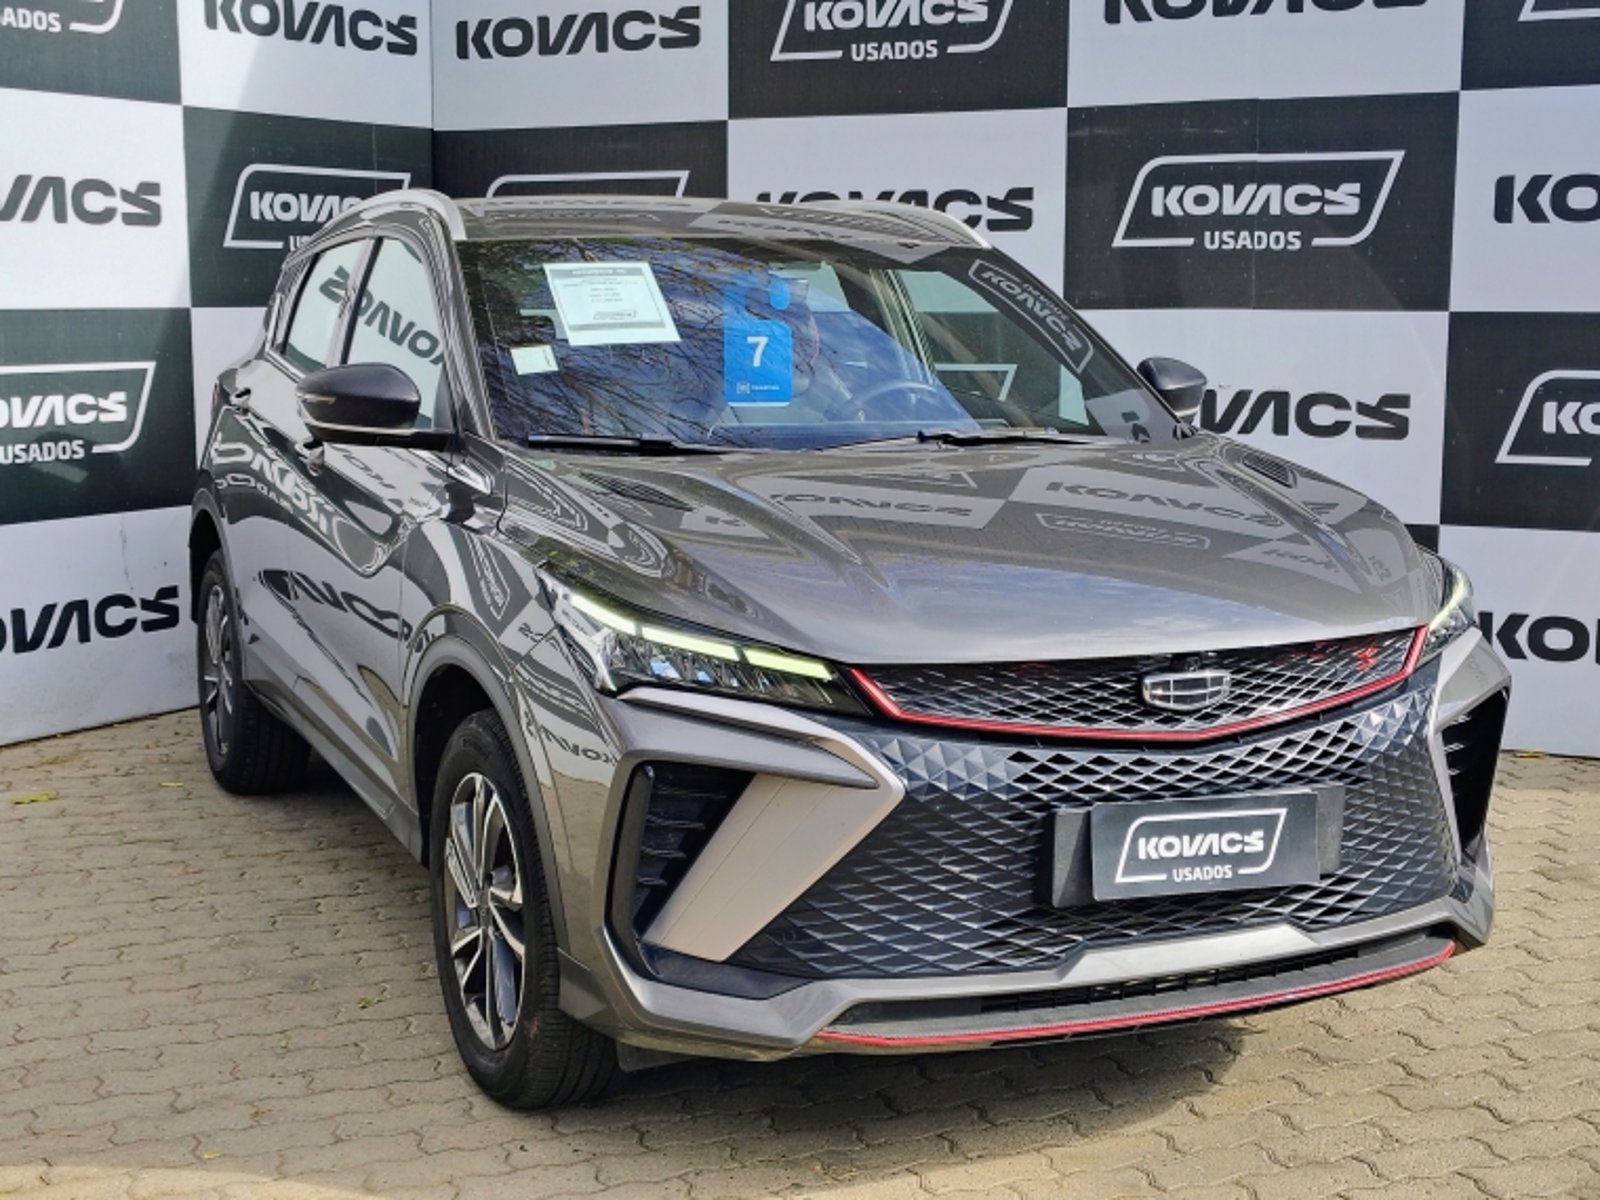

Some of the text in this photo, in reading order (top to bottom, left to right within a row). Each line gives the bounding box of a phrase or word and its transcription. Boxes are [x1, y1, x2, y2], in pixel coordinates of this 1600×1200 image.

[0, 6, 61, 32] ADOS
[204, 0, 418, 56] KOVACS
[804, 0, 988, 31] KOVACS
[456, 8, 701, 60] KOVACS
[851, 40, 938, 62] USADOS
[1151, 183, 1361, 217] KOVACS
[1204, 230, 1302, 251] USADOS
[747, 336, 768, 367] 7
[0, 391, 127, 428] VACS
[1201, 389, 1411, 440] VACS
[0, 585, 180, 654] VACS
[1478, 611, 1600, 666] KO
[1138, 830, 1264, 860] KOVACS
[1172, 865, 1233, 883] USADOS
